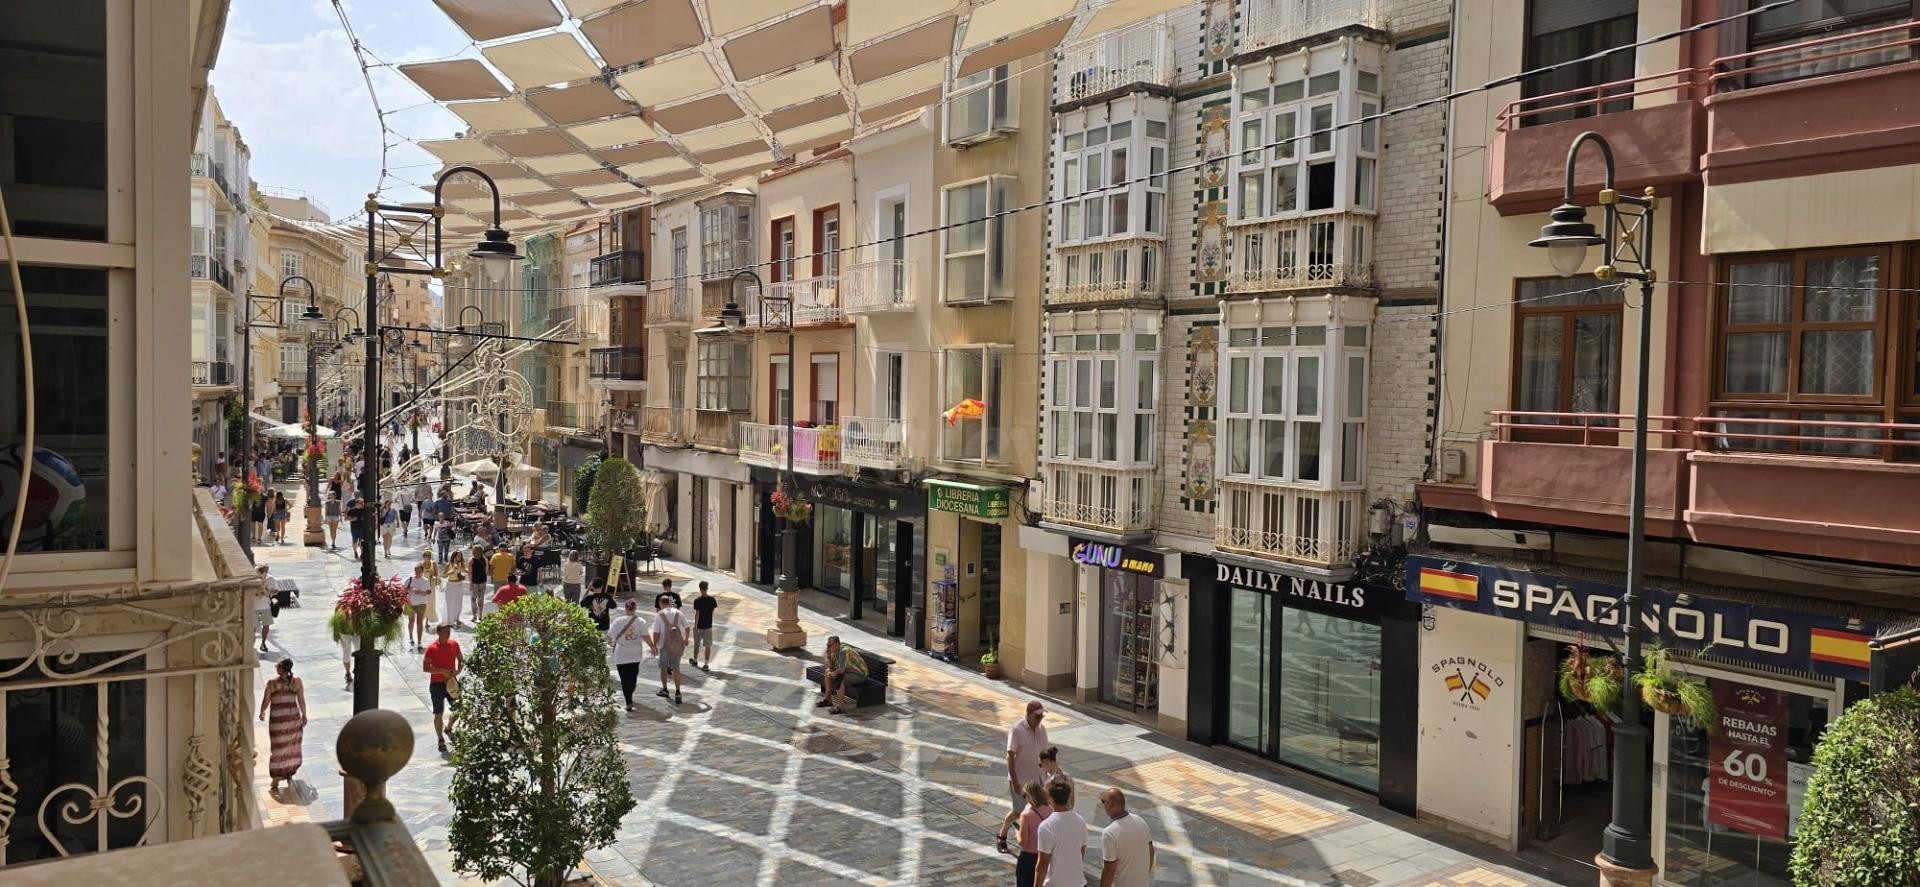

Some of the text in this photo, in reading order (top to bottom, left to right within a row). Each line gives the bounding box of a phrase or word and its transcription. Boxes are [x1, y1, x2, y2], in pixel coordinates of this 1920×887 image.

[945, 488, 980, 502] LIBRERIA
[936, 498, 980, 516] DIOCESANA
[1216, 563, 1365, 608] DAILY NAILS
[1493, 578, 1790, 655] SPAGNOLO
[1431, 656, 1504, 687] SPAGNOLO
[1722, 716, 1777, 736] REBAJAS
[1728, 730, 1770, 746] HASTA EL
[1718, 777, 1728, 787] DE
